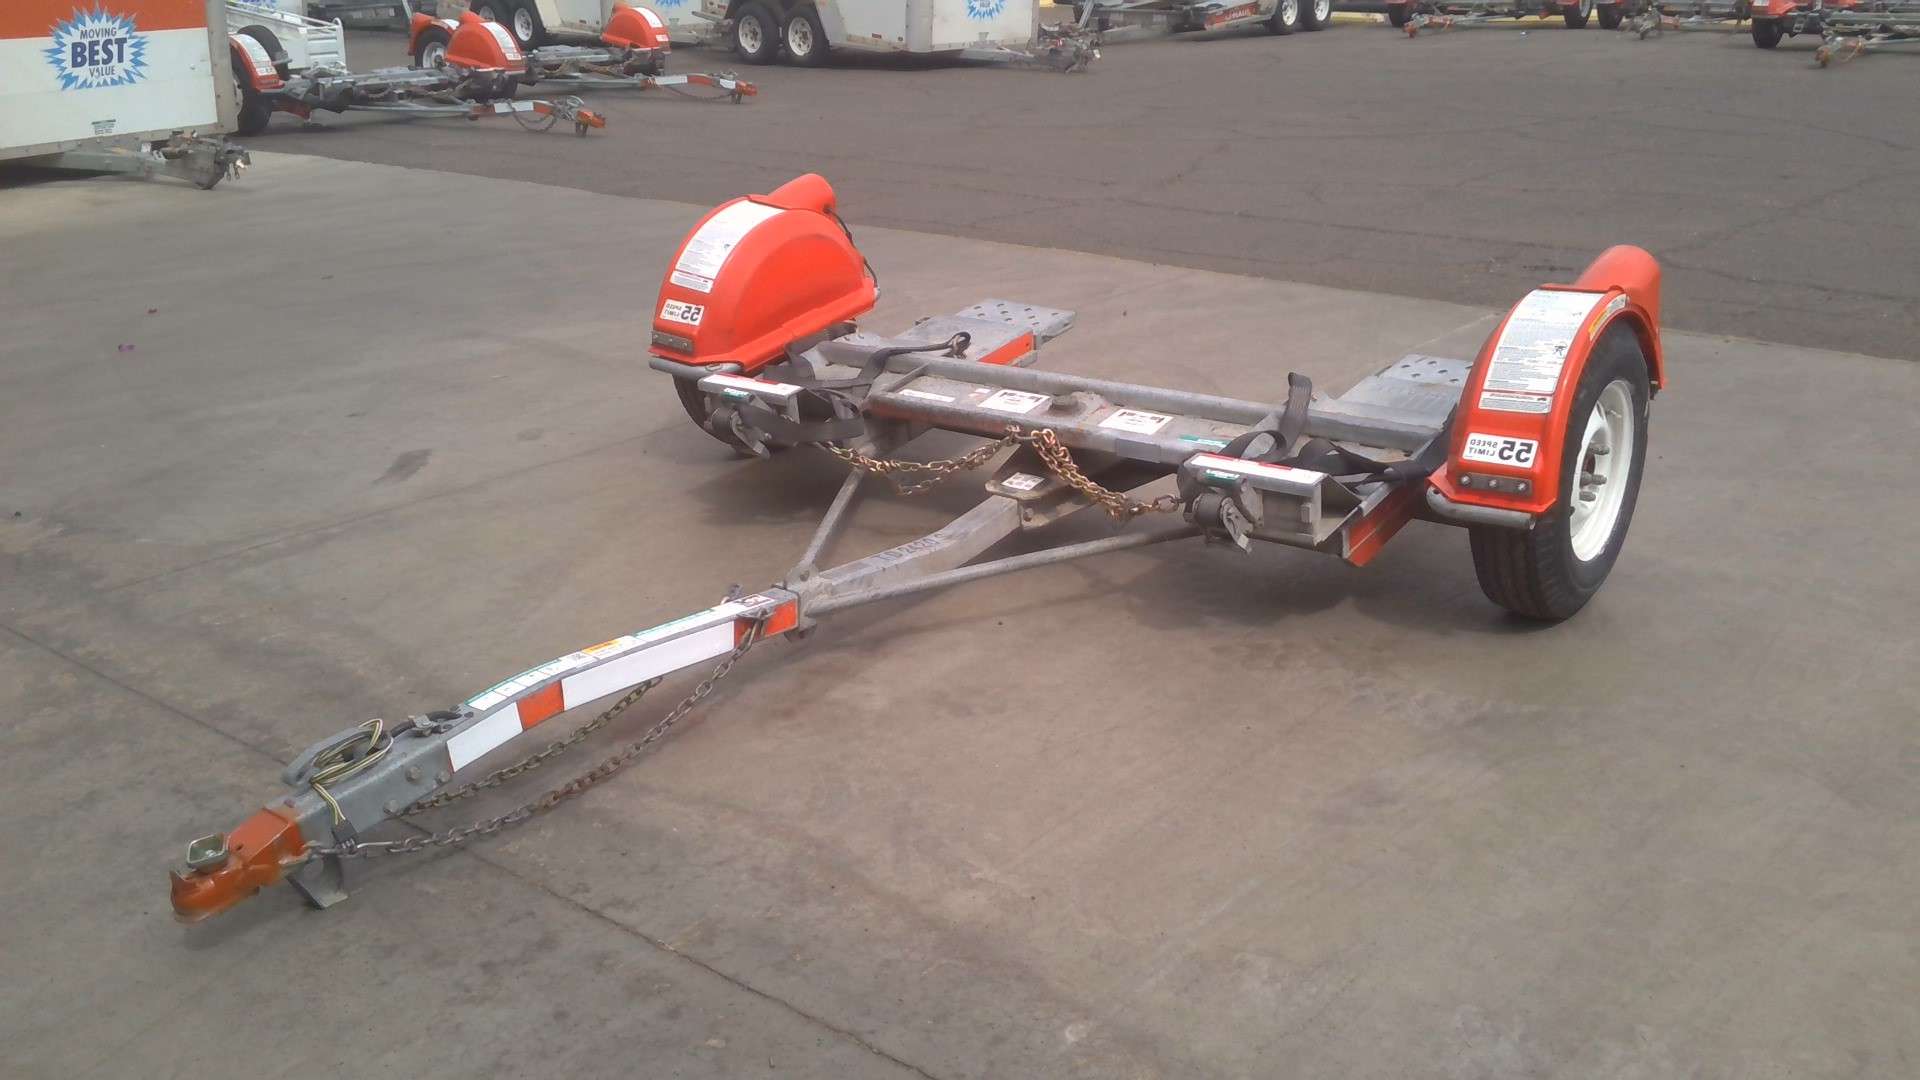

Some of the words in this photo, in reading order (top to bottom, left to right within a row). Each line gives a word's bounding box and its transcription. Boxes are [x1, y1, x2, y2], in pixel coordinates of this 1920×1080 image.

[80, 27, 117, 39] MOVING
[71, 37, 127, 68] BEST
[89, 65, 115, 78] VALUE
